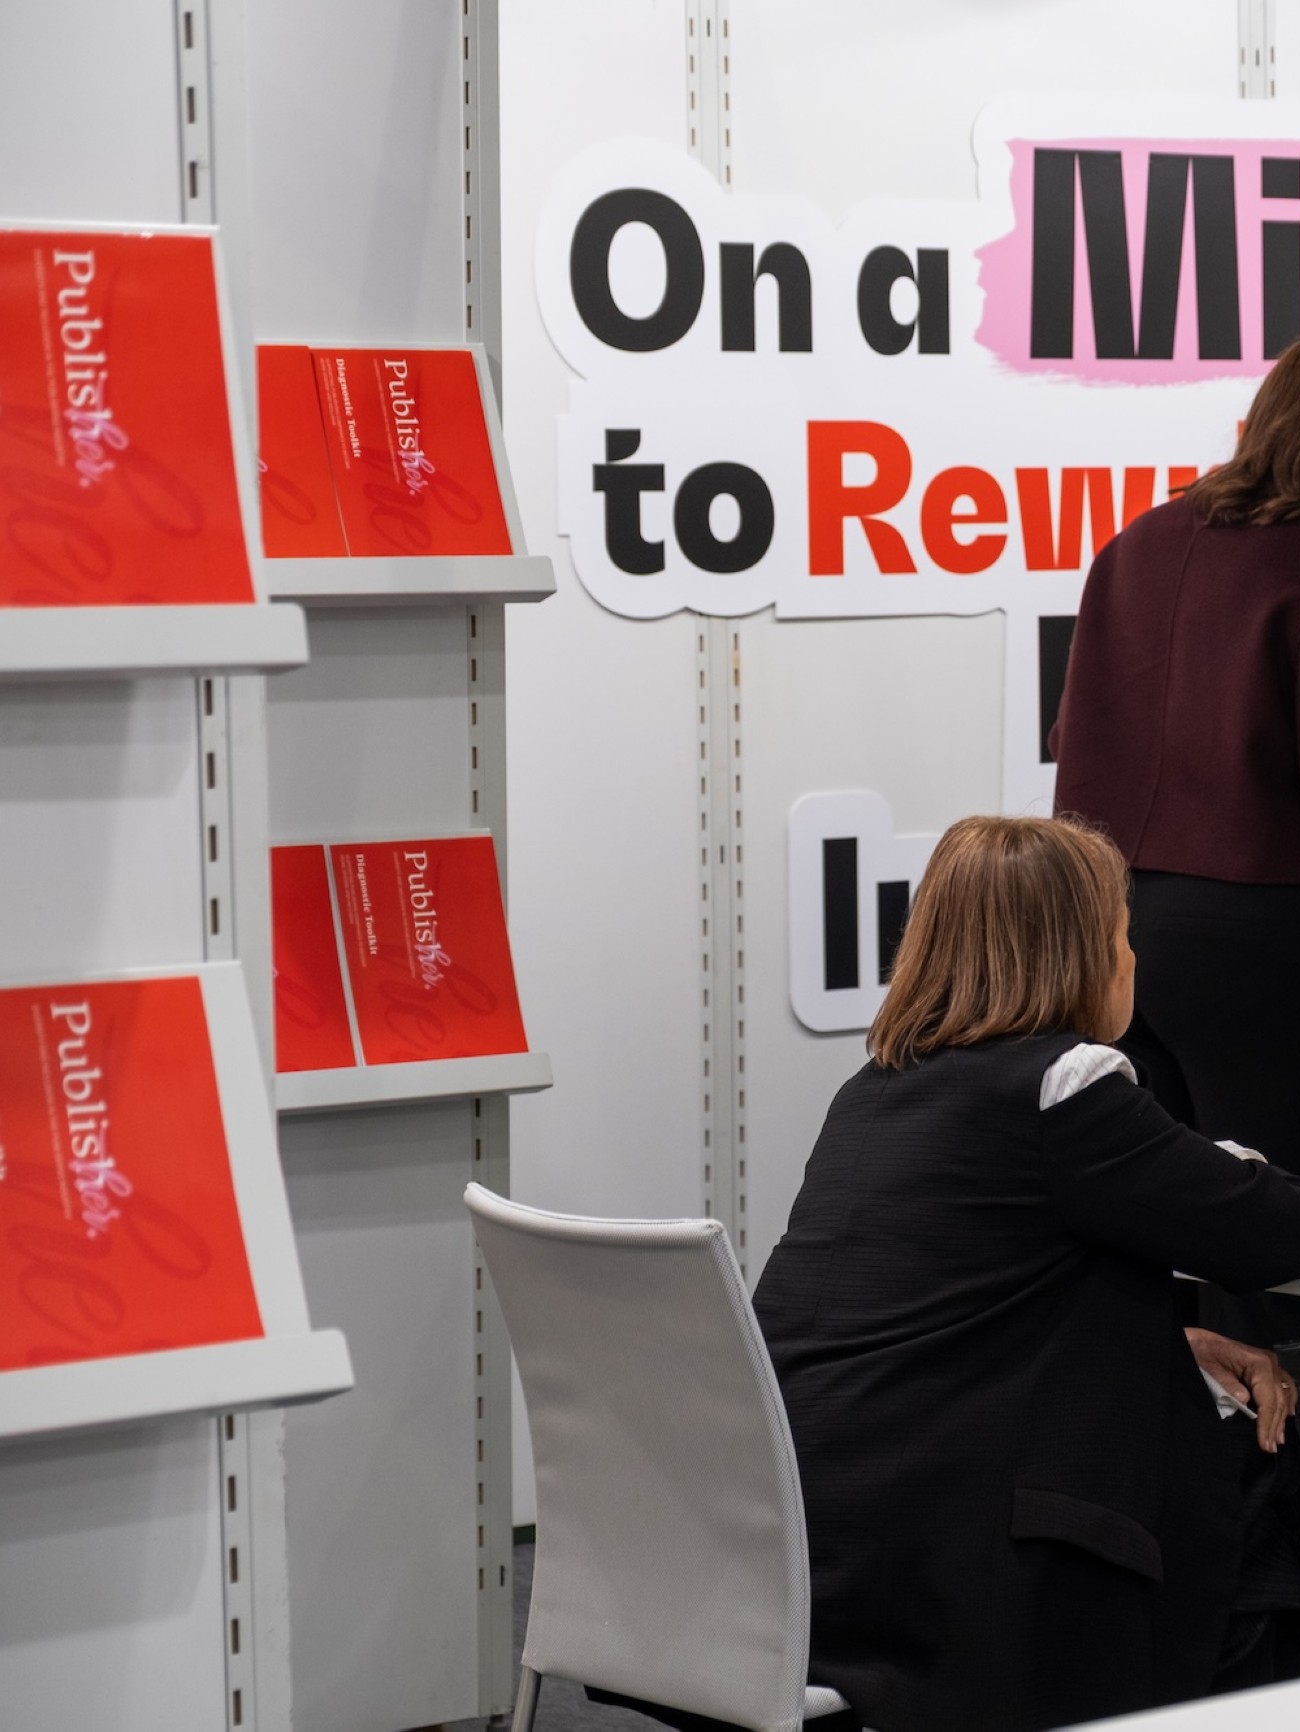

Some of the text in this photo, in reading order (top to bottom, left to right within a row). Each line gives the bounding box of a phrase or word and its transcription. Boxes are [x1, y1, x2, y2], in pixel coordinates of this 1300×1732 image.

[570, 187, 813, 353] On
[857, 244, 950, 356] a
[336, 358, 362, 459] Diagnostic Toolkit
[592, 429, 775, 576] to
[364, 915, 378, 956] Toolkit
